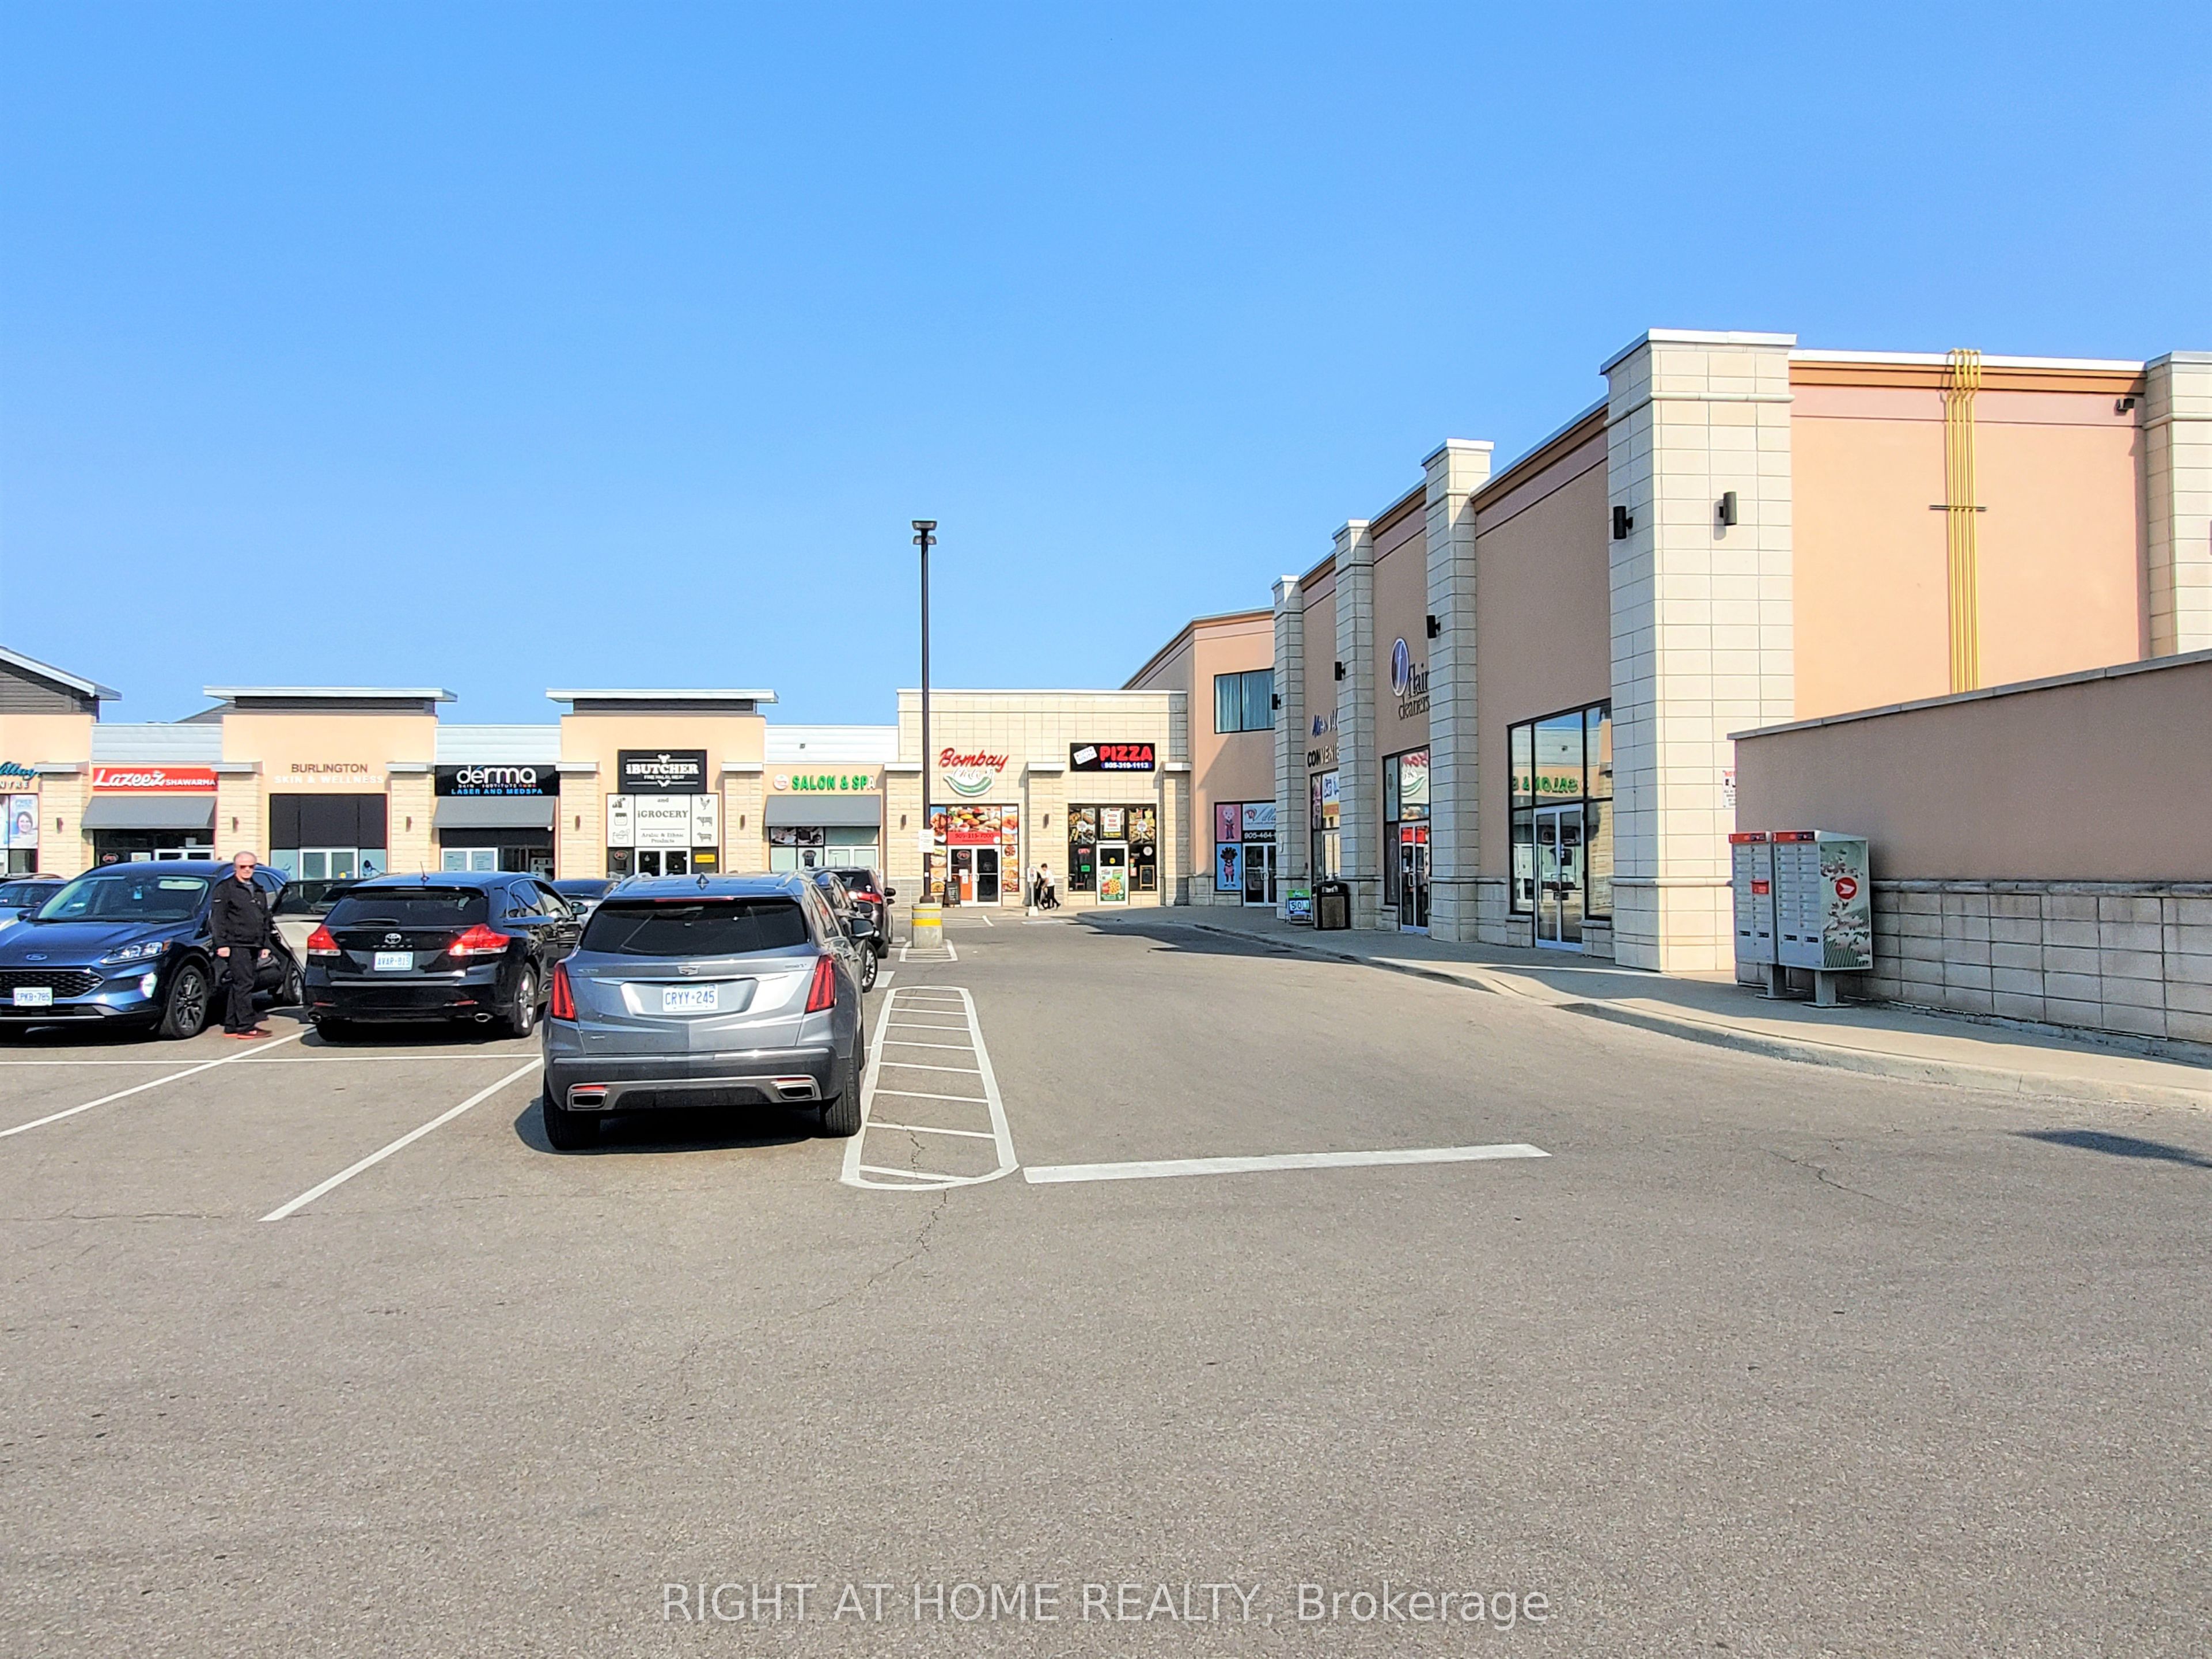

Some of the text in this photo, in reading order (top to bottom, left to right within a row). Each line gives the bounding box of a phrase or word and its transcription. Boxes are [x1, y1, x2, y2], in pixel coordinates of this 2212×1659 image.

[1398, 695, 1430, 721] cleaners
[939, 748, 1009, 772] Bombay
[1100, 745, 1153, 761] PIZZA
[1307, 743, 1339, 768] CONVENIE
[291, 764, 368, 773] BURLINGTON
[626, 764, 699, 774] iBUTCHER
[274, 776, 303, 784] SKIN
[321, 775, 384, 784] WELLNESS
[792, 775, 876, 790] SALON & SPA
[638, 810, 688, 818] iGROCERY
[665, 991, 715, 1005] CRYY 245
